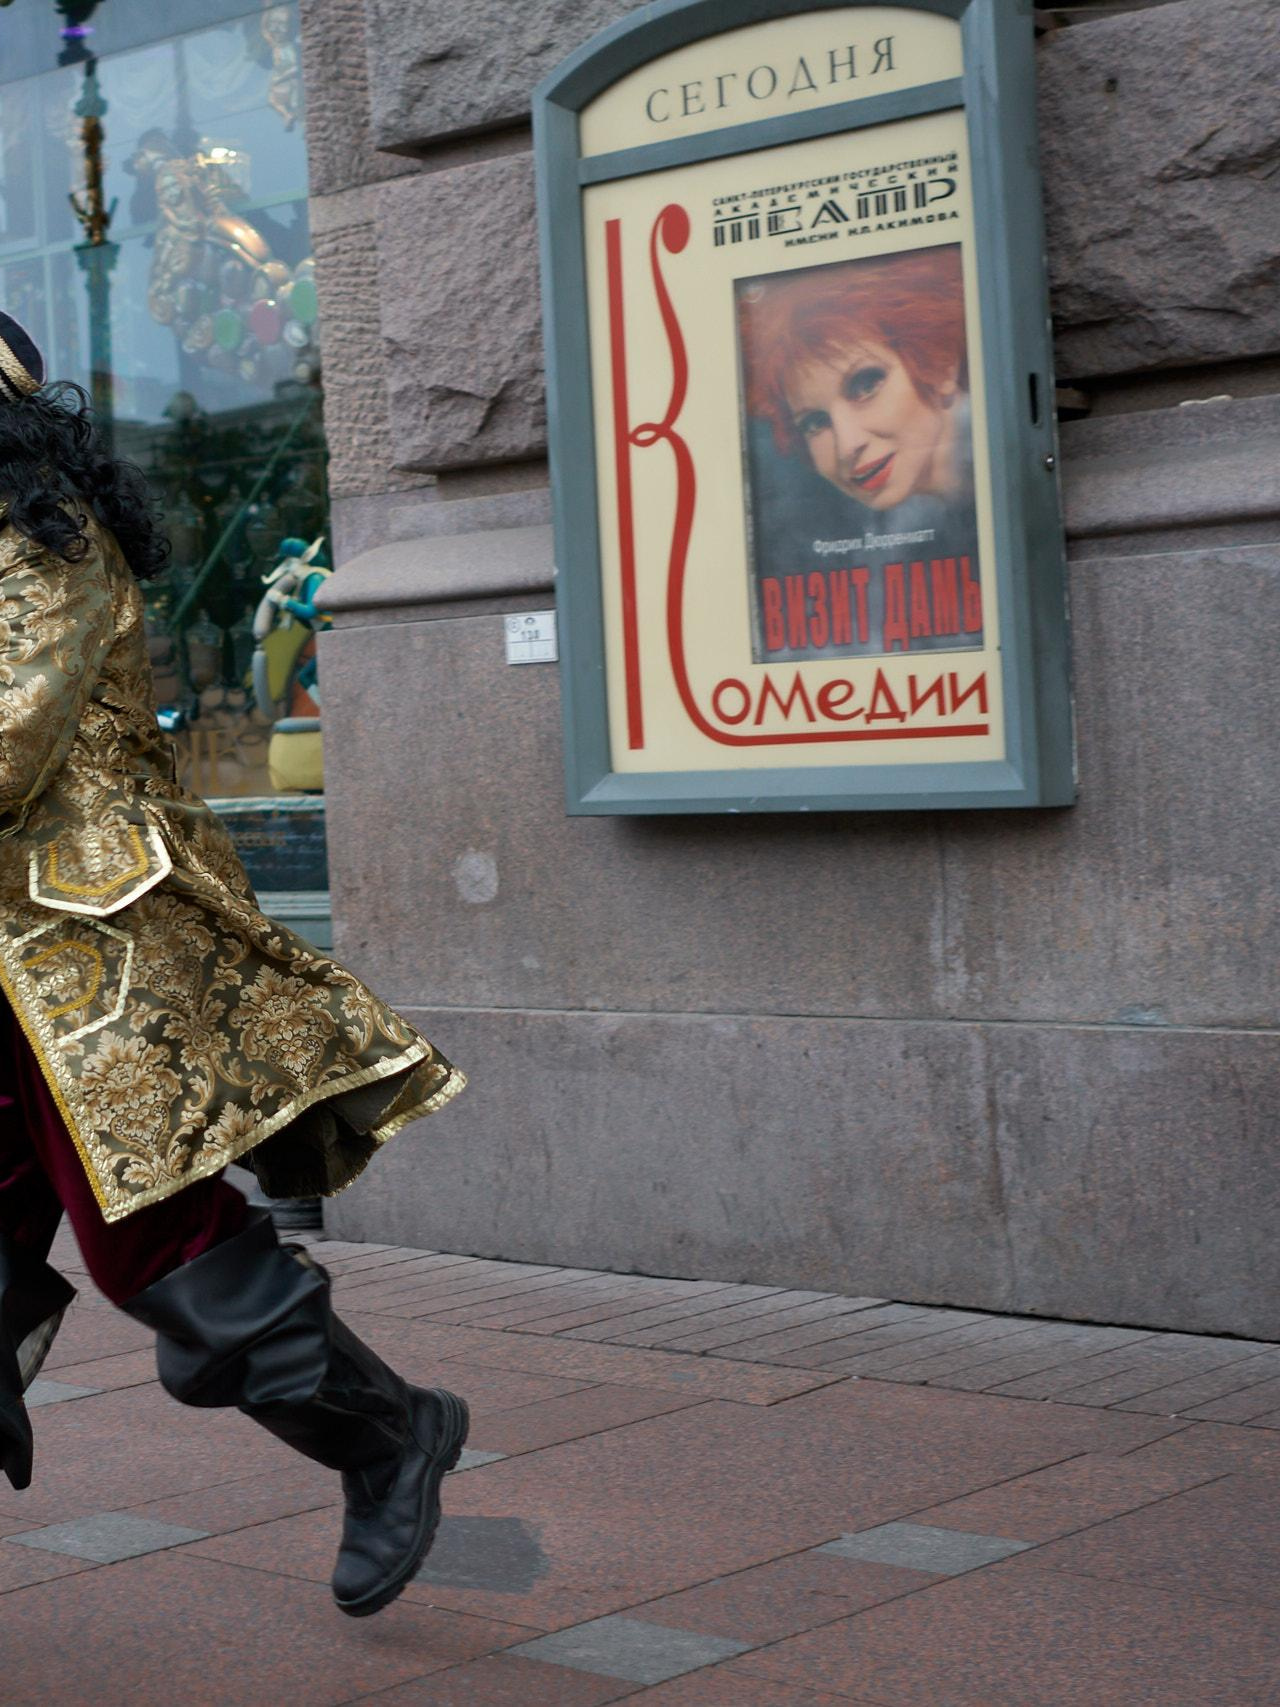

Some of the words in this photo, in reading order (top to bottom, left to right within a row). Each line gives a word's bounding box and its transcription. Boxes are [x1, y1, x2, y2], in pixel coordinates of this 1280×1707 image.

[645, 35, 897, 123] СЕГОДНЯ
[714, 162, 959, 217] АКАДЕМИЧЕСКИЙ
[843, 151, 958, 182] ГОСУДАРСТВЕННЫЙ
[784, 230, 840, 247] ИМЕНИ
[761, 566, 870, 653] ВИЗИТ
